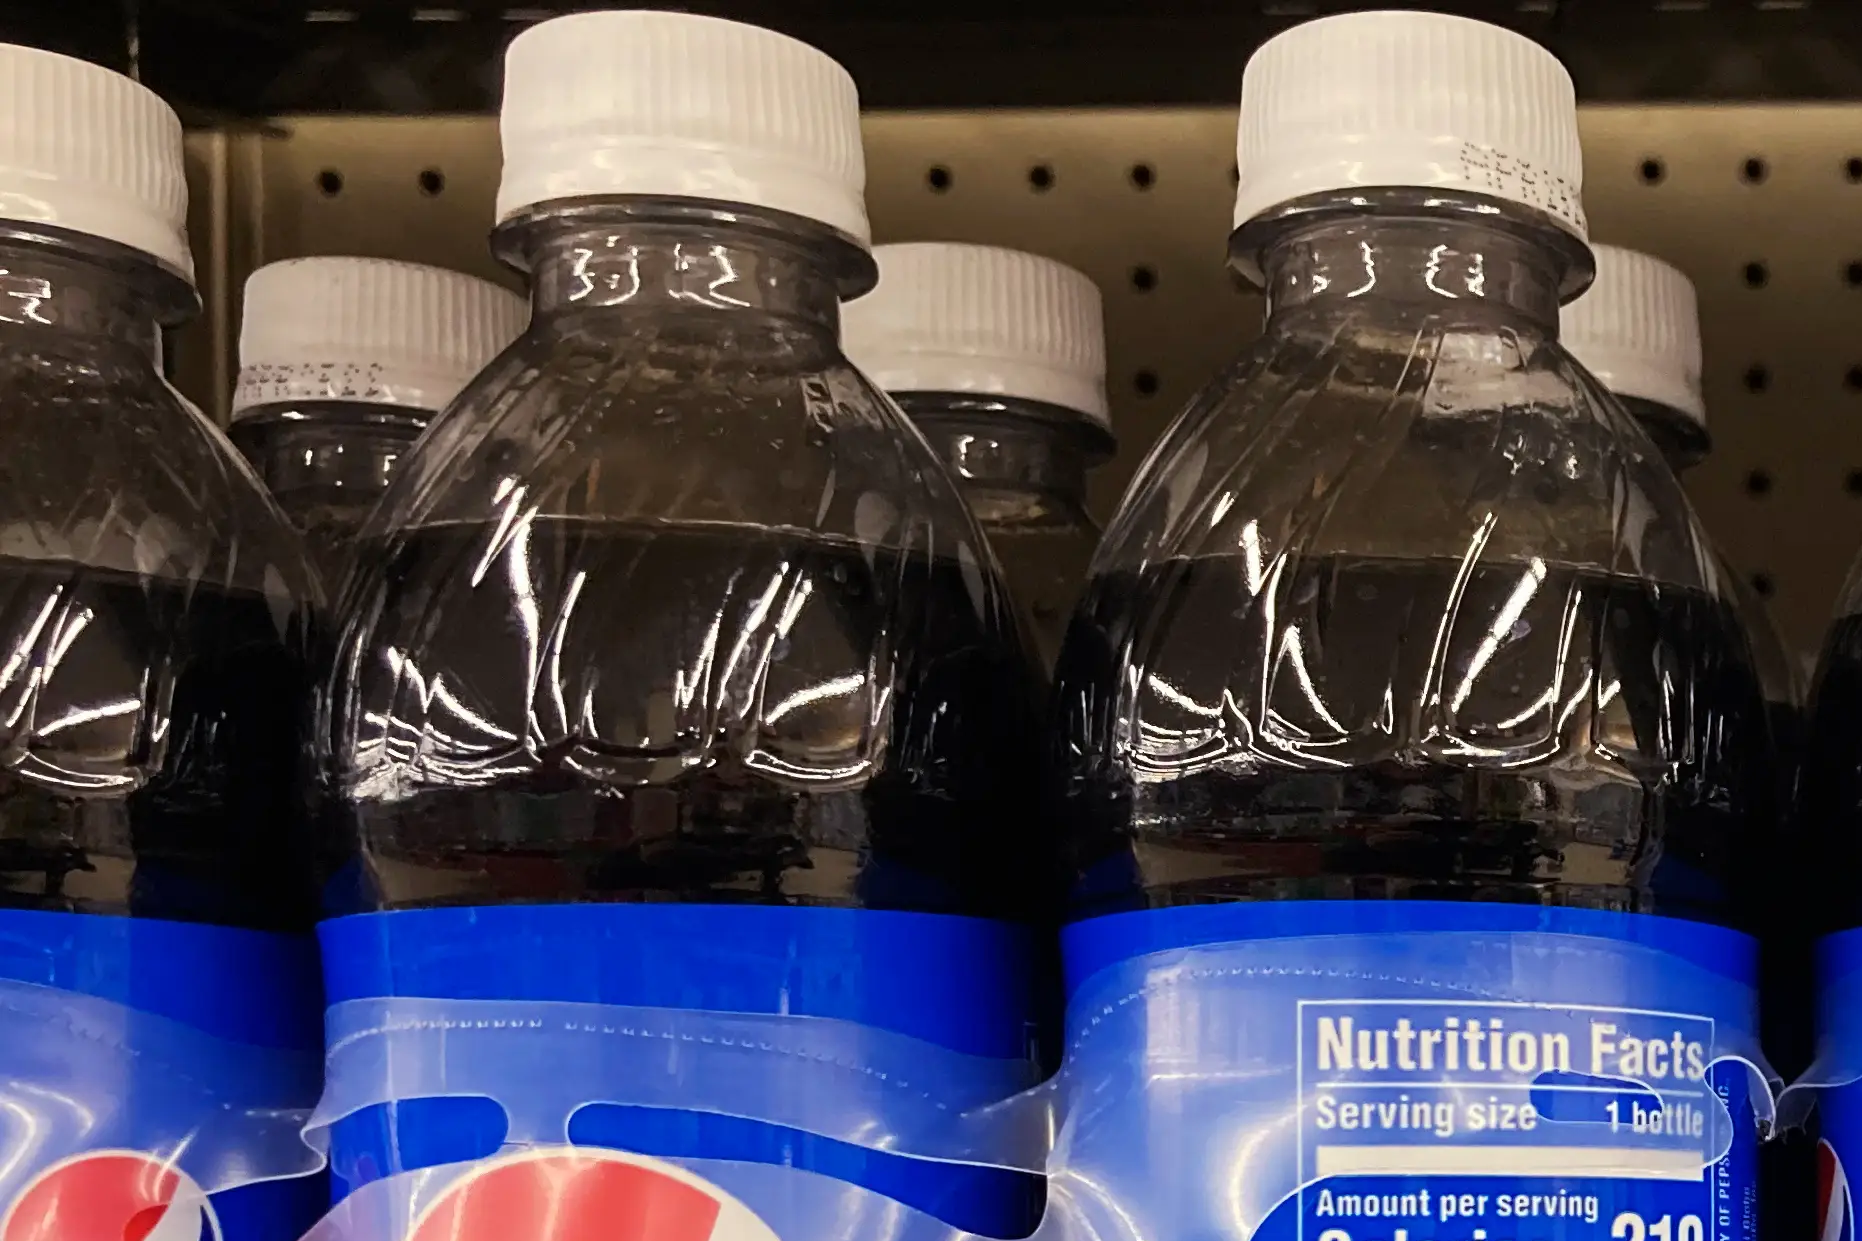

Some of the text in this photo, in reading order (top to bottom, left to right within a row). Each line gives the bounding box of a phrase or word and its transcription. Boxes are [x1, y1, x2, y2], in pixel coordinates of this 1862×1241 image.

[1315, 1016, 1705, 1081] Nutrition Facts
[1315, 1094, 1537, 1137] Serving size
[1605, 1101, 1620, 1133] 1
[1631, 1100, 1705, 1138] bottle
[1315, 1188, 1599, 1223] Amount per serving
[1719, 1206, 1730, 1227] OF
